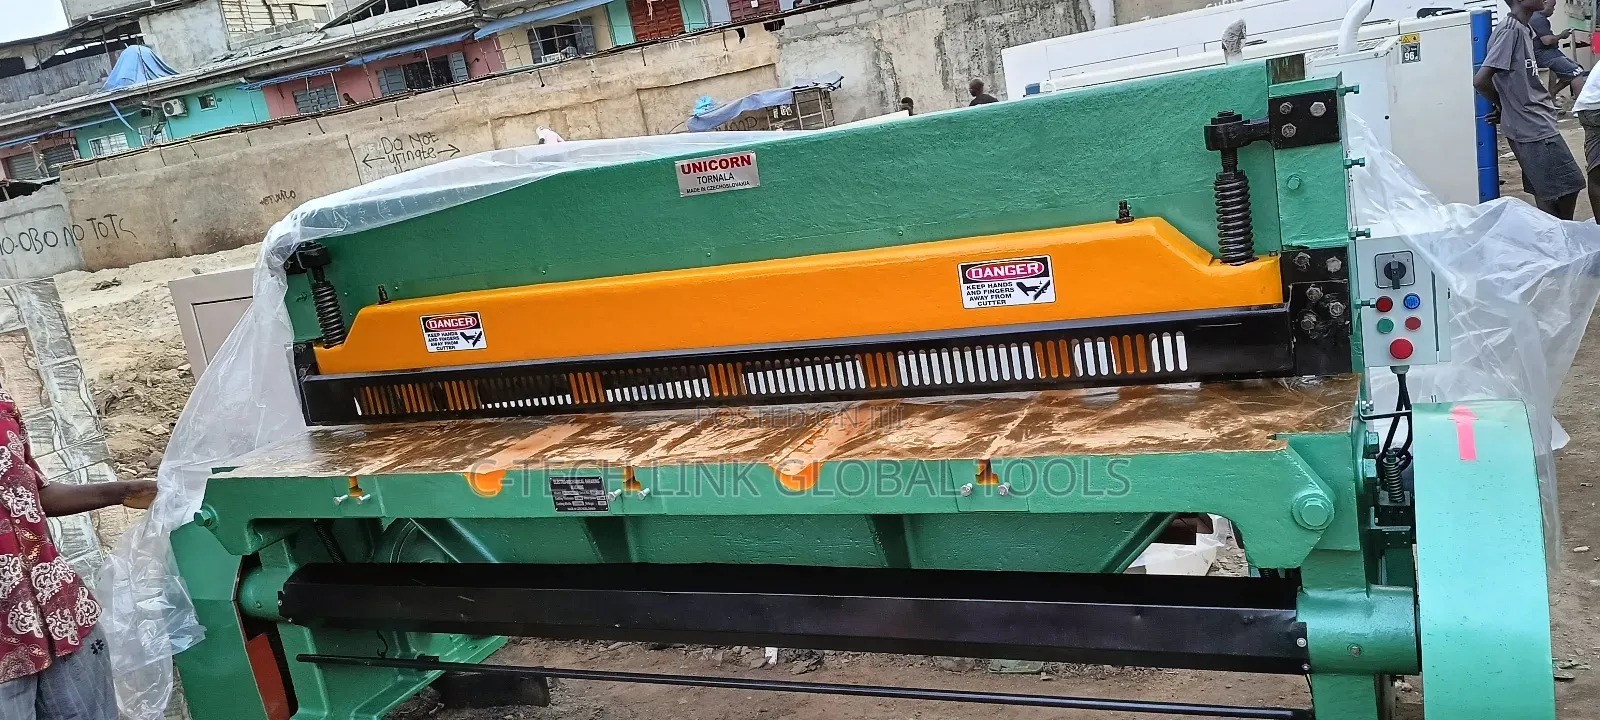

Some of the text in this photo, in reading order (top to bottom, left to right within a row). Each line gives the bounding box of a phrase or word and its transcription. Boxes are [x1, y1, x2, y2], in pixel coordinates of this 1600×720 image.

[680, 155, 752, 174] UNICORN
[697, 172, 735, 184] TORNALA
[971, 263, 1039, 278] DANGER
[429, 318, 473, 328] DANGER
